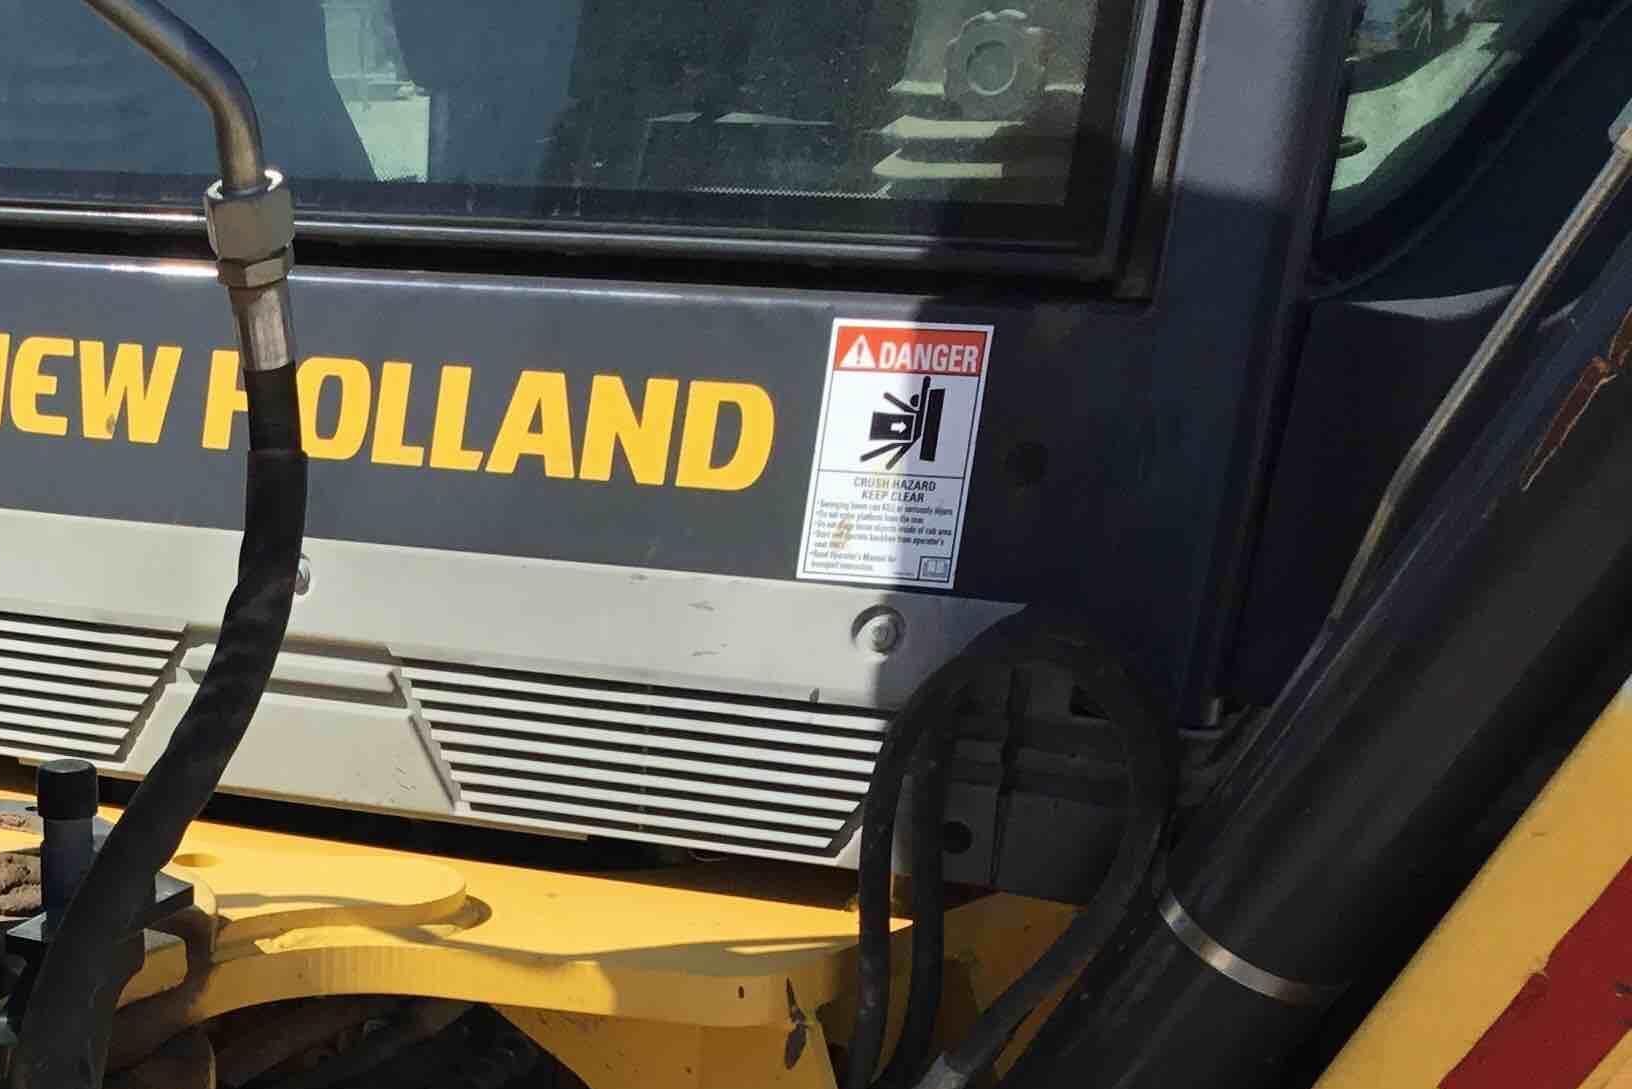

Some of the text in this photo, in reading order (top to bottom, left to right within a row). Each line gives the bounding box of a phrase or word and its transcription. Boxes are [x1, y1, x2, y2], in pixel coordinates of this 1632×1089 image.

[879, 341, 978, 373] DANGER
[853, 476, 937, 492] CRUSH HAZARD
[861, 489, 926, 503] KEEP CLEAR
